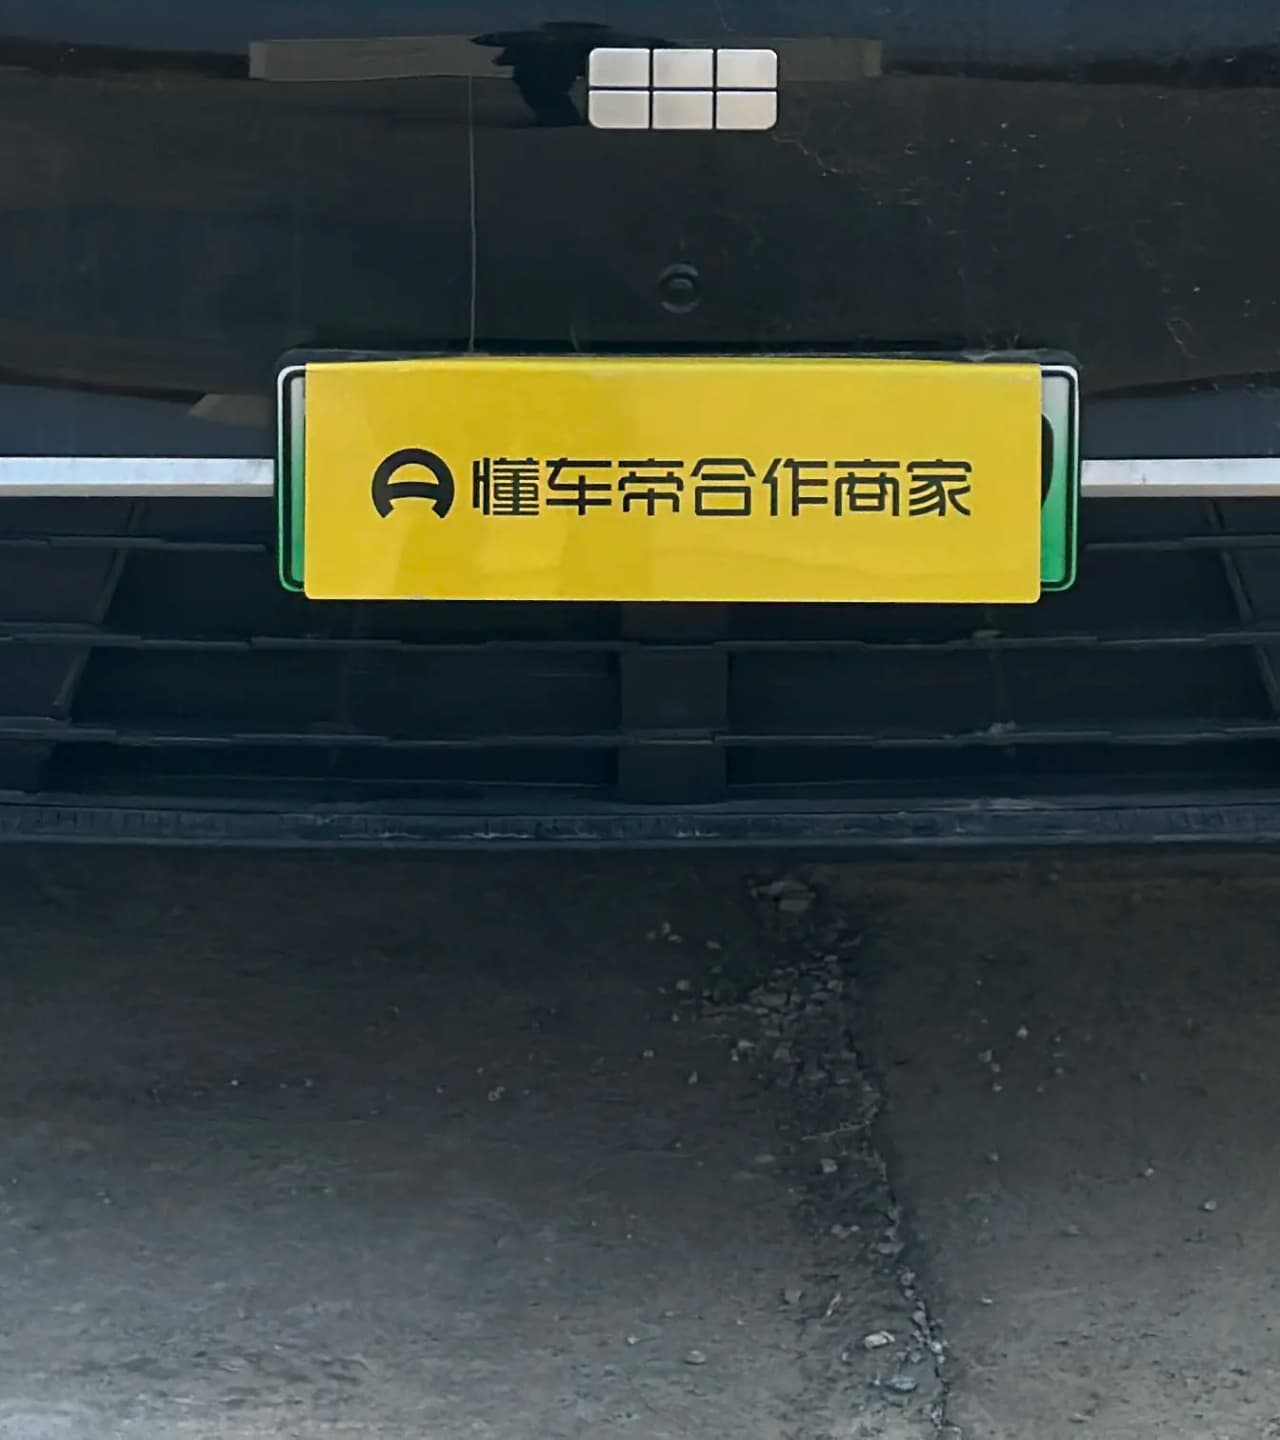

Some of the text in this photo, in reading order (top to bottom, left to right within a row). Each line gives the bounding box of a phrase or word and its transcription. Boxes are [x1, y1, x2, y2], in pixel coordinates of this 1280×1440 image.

[472, 456, 972, 517] 懂车帝合作商家
